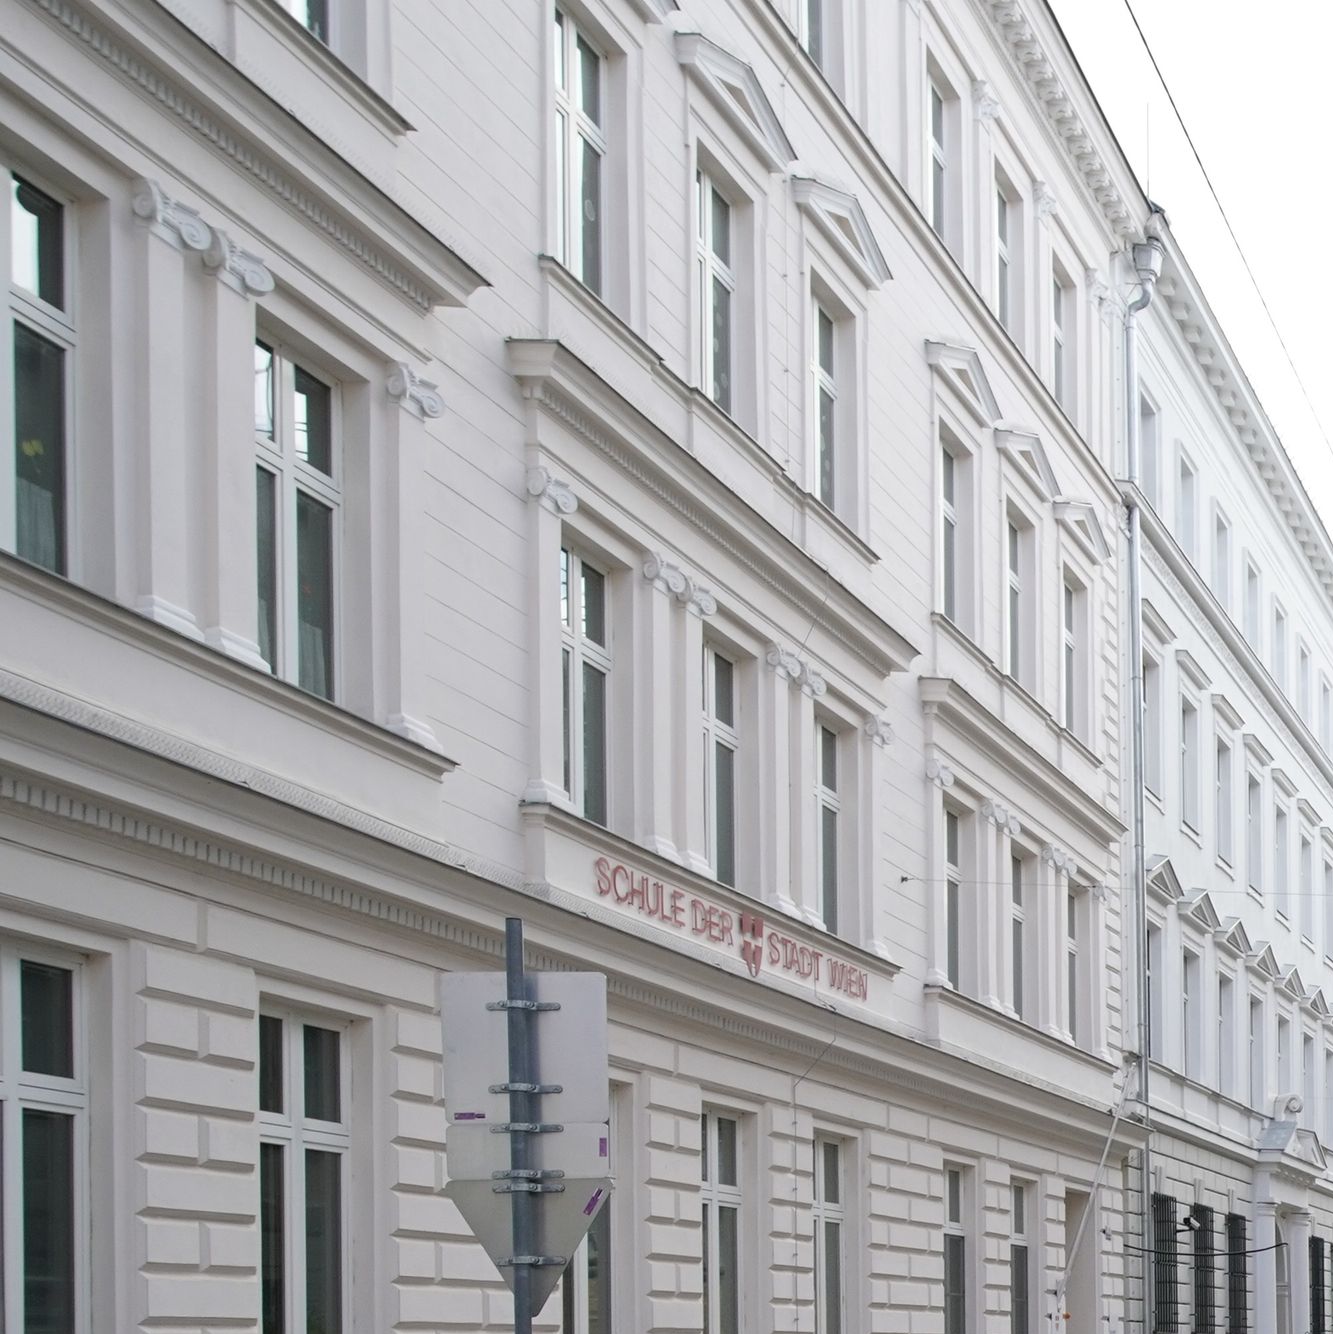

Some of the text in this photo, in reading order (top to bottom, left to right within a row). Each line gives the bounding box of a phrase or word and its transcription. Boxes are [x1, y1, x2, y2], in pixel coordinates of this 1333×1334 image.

[594, 857, 868, 1001] SCHULE DER STADT WIEN
